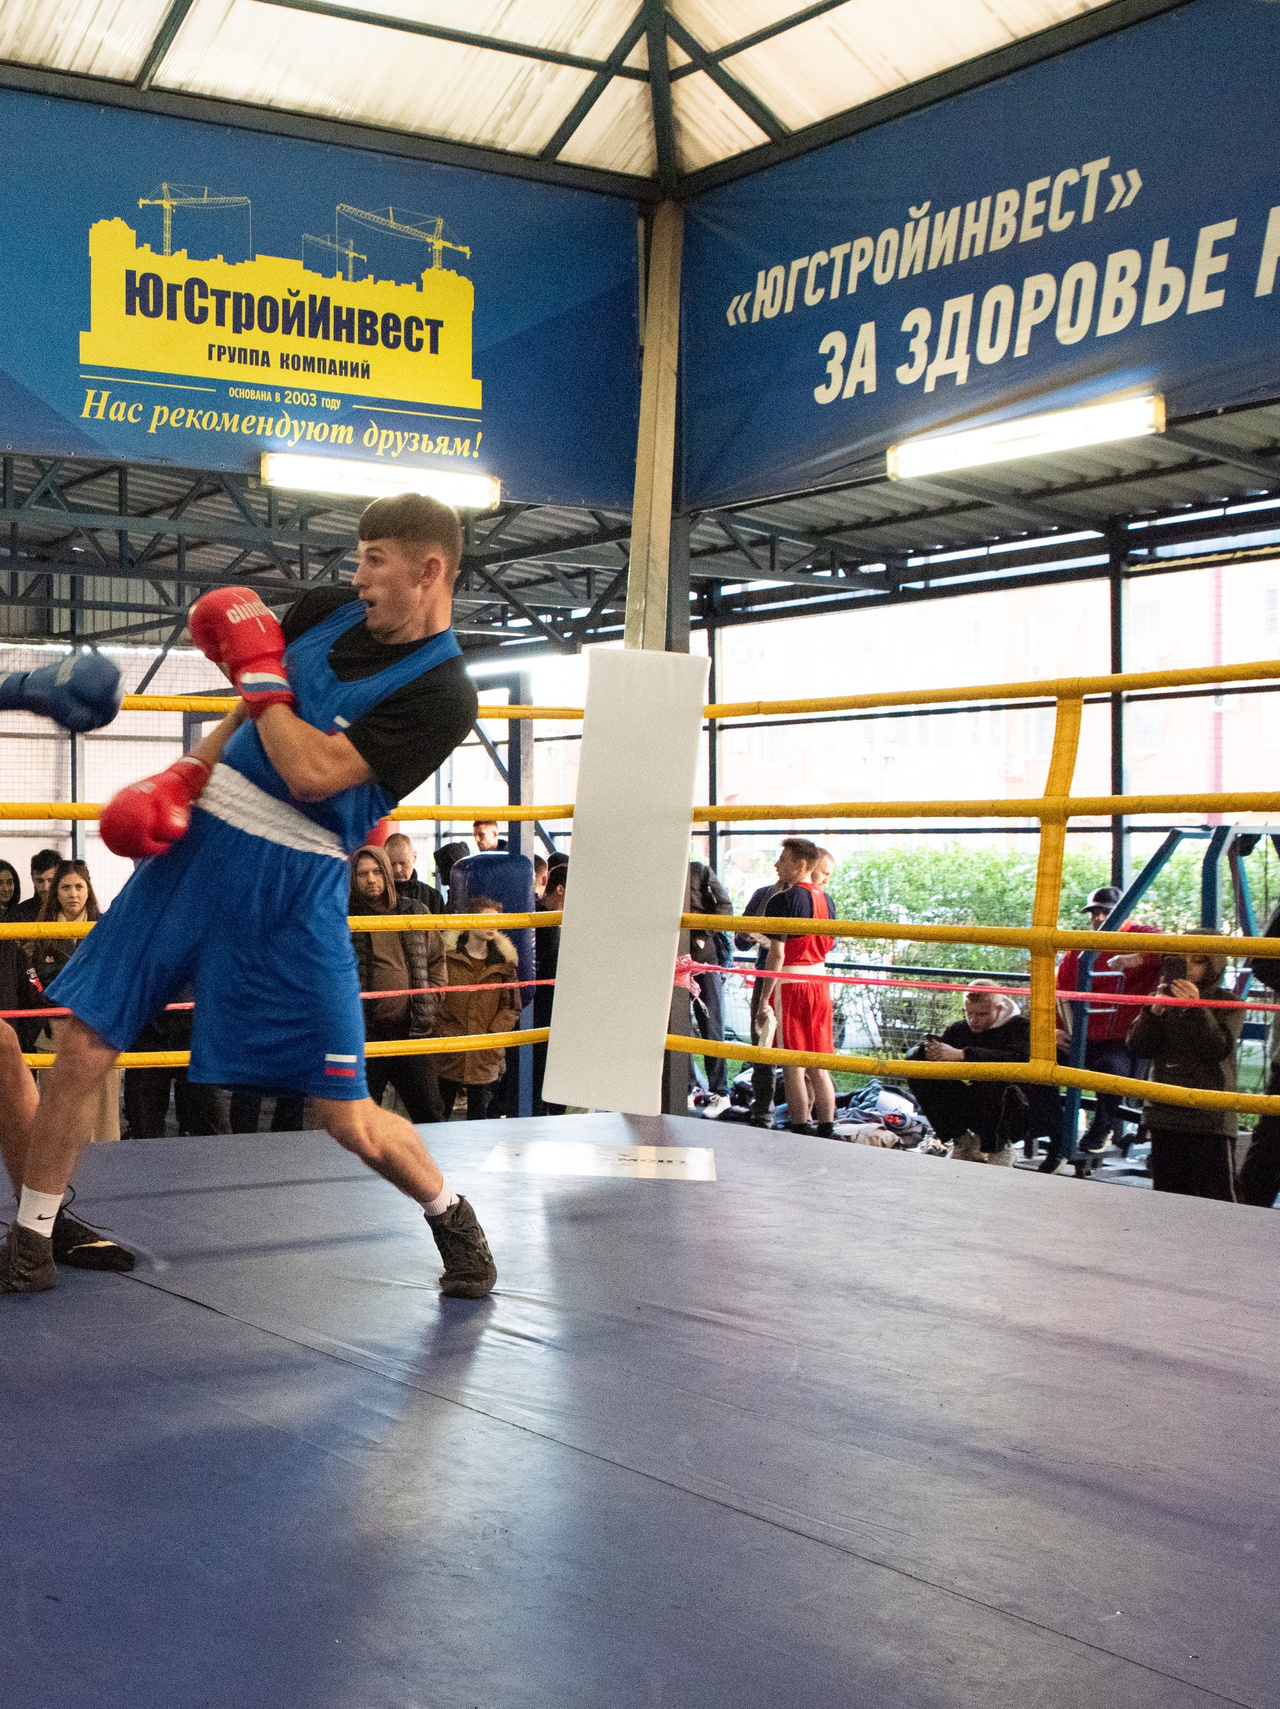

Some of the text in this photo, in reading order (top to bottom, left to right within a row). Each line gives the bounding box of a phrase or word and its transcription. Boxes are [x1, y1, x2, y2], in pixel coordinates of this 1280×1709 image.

[726, 156, 1144, 327] «ЮГСТРОЙИНВЕСТ»
[125, 270, 444, 354] ЮгСтройИнвест
[814, 321, 878, 405] ЗА
[895, 218, 1239, 393] ЗДОРОВЬЕ
[208, 344, 371, 379] ГРУППА КОМПАНИЙ
[229, 388, 272, 402] ОСНОВАНА
[283, 390, 318, 407] 2003
[79, 389, 483, 458] Нас рекомендуют друзьям!
